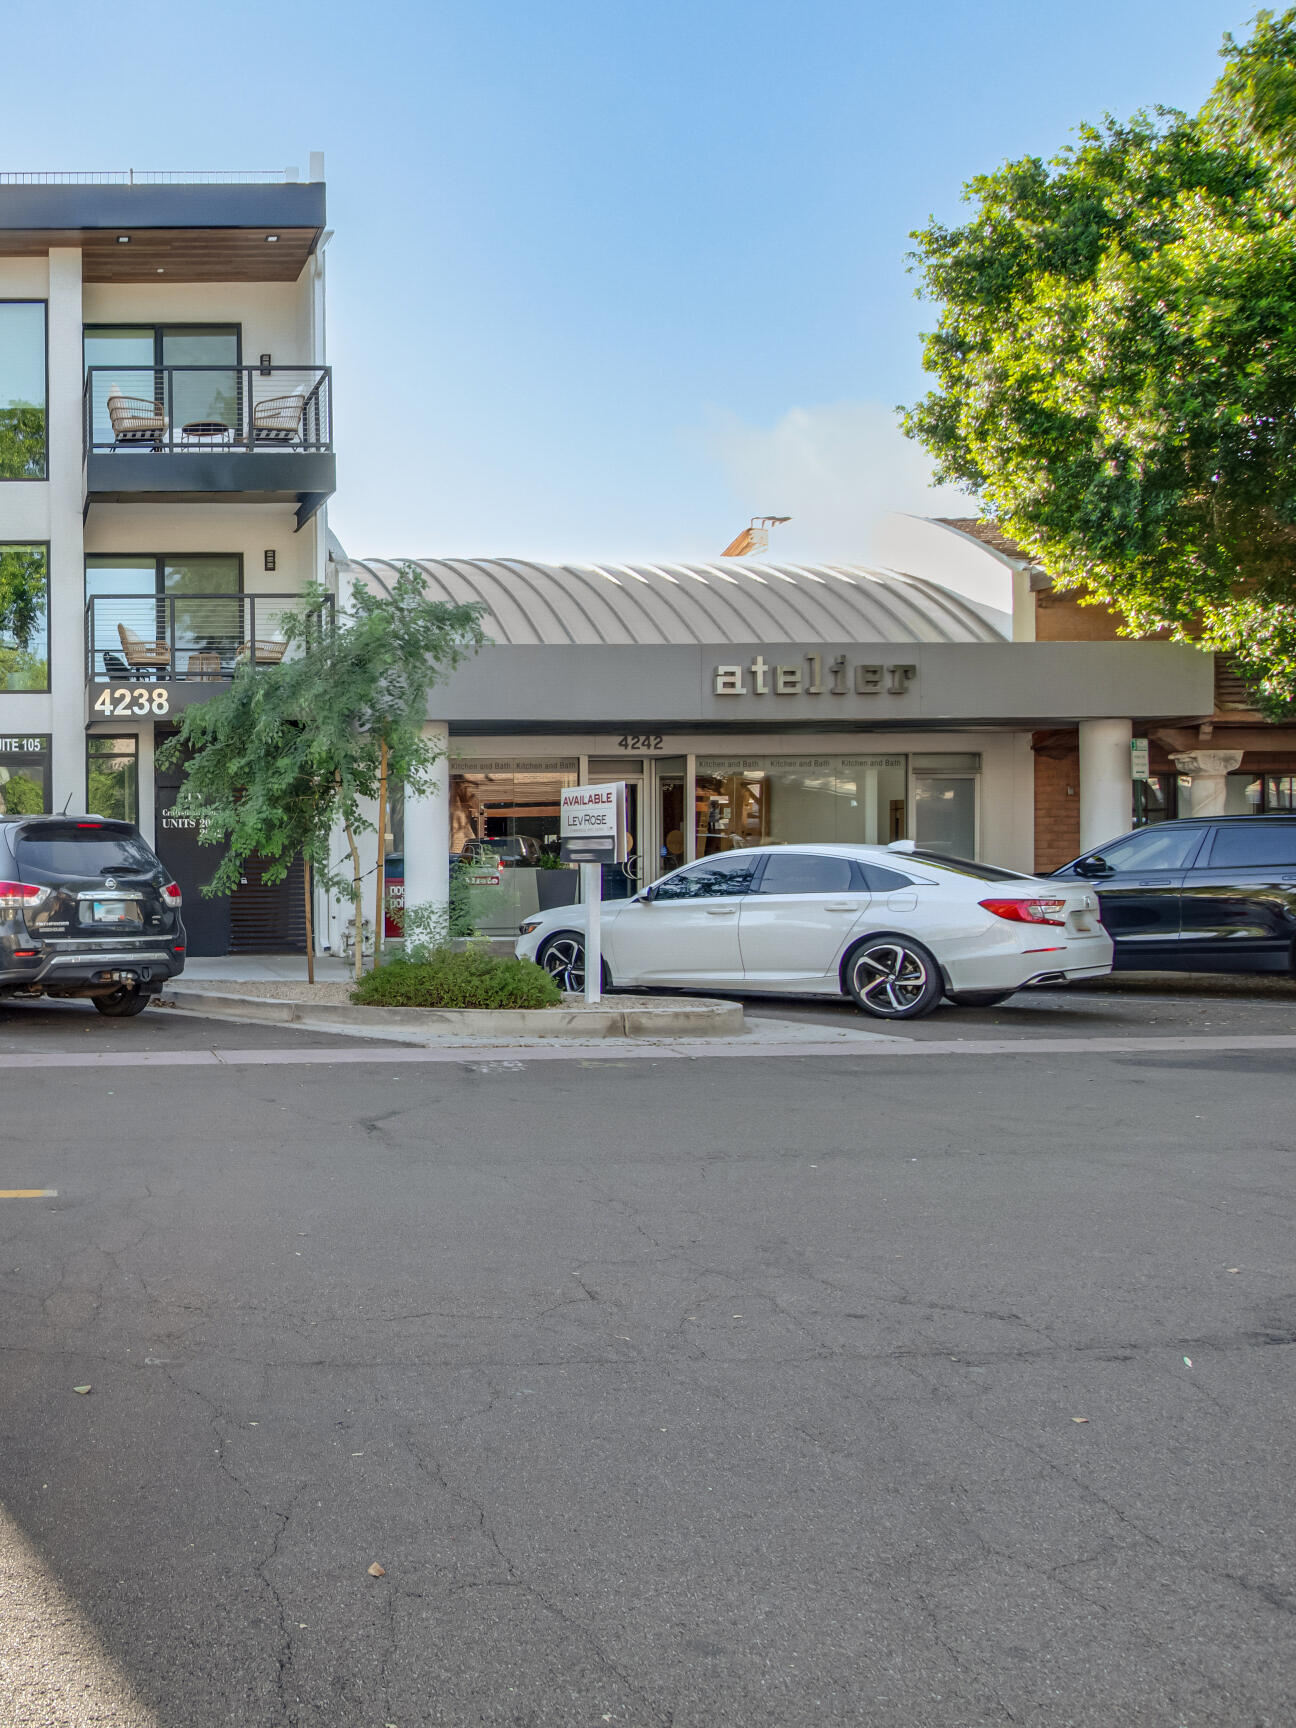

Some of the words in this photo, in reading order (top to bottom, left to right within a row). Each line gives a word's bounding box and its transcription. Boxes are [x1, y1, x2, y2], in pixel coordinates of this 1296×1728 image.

[714, 652, 917, 695] atelier
[95, 688, 169, 716] 4238
[22, 738, 41, 751] 105
[618, 735, 664, 751] 4242
[451, 762, 478, 770] Kitchen
[494, 762, 511, 770] Bath
[516, 761, 543, 770] Kitchen
[545, 762, 558, 770] and
[560, 761, 576, 770] Bath
[699, 761, 726, 769] Kitchen
[743, 761, 759, 769] Bath
[770, 760, 797, 768] Kitchen
[813, 760, 830, 768] Bath
[563, 792, 613, 807] AVAILABLE
[162, 818, 196, 829] UNITS
